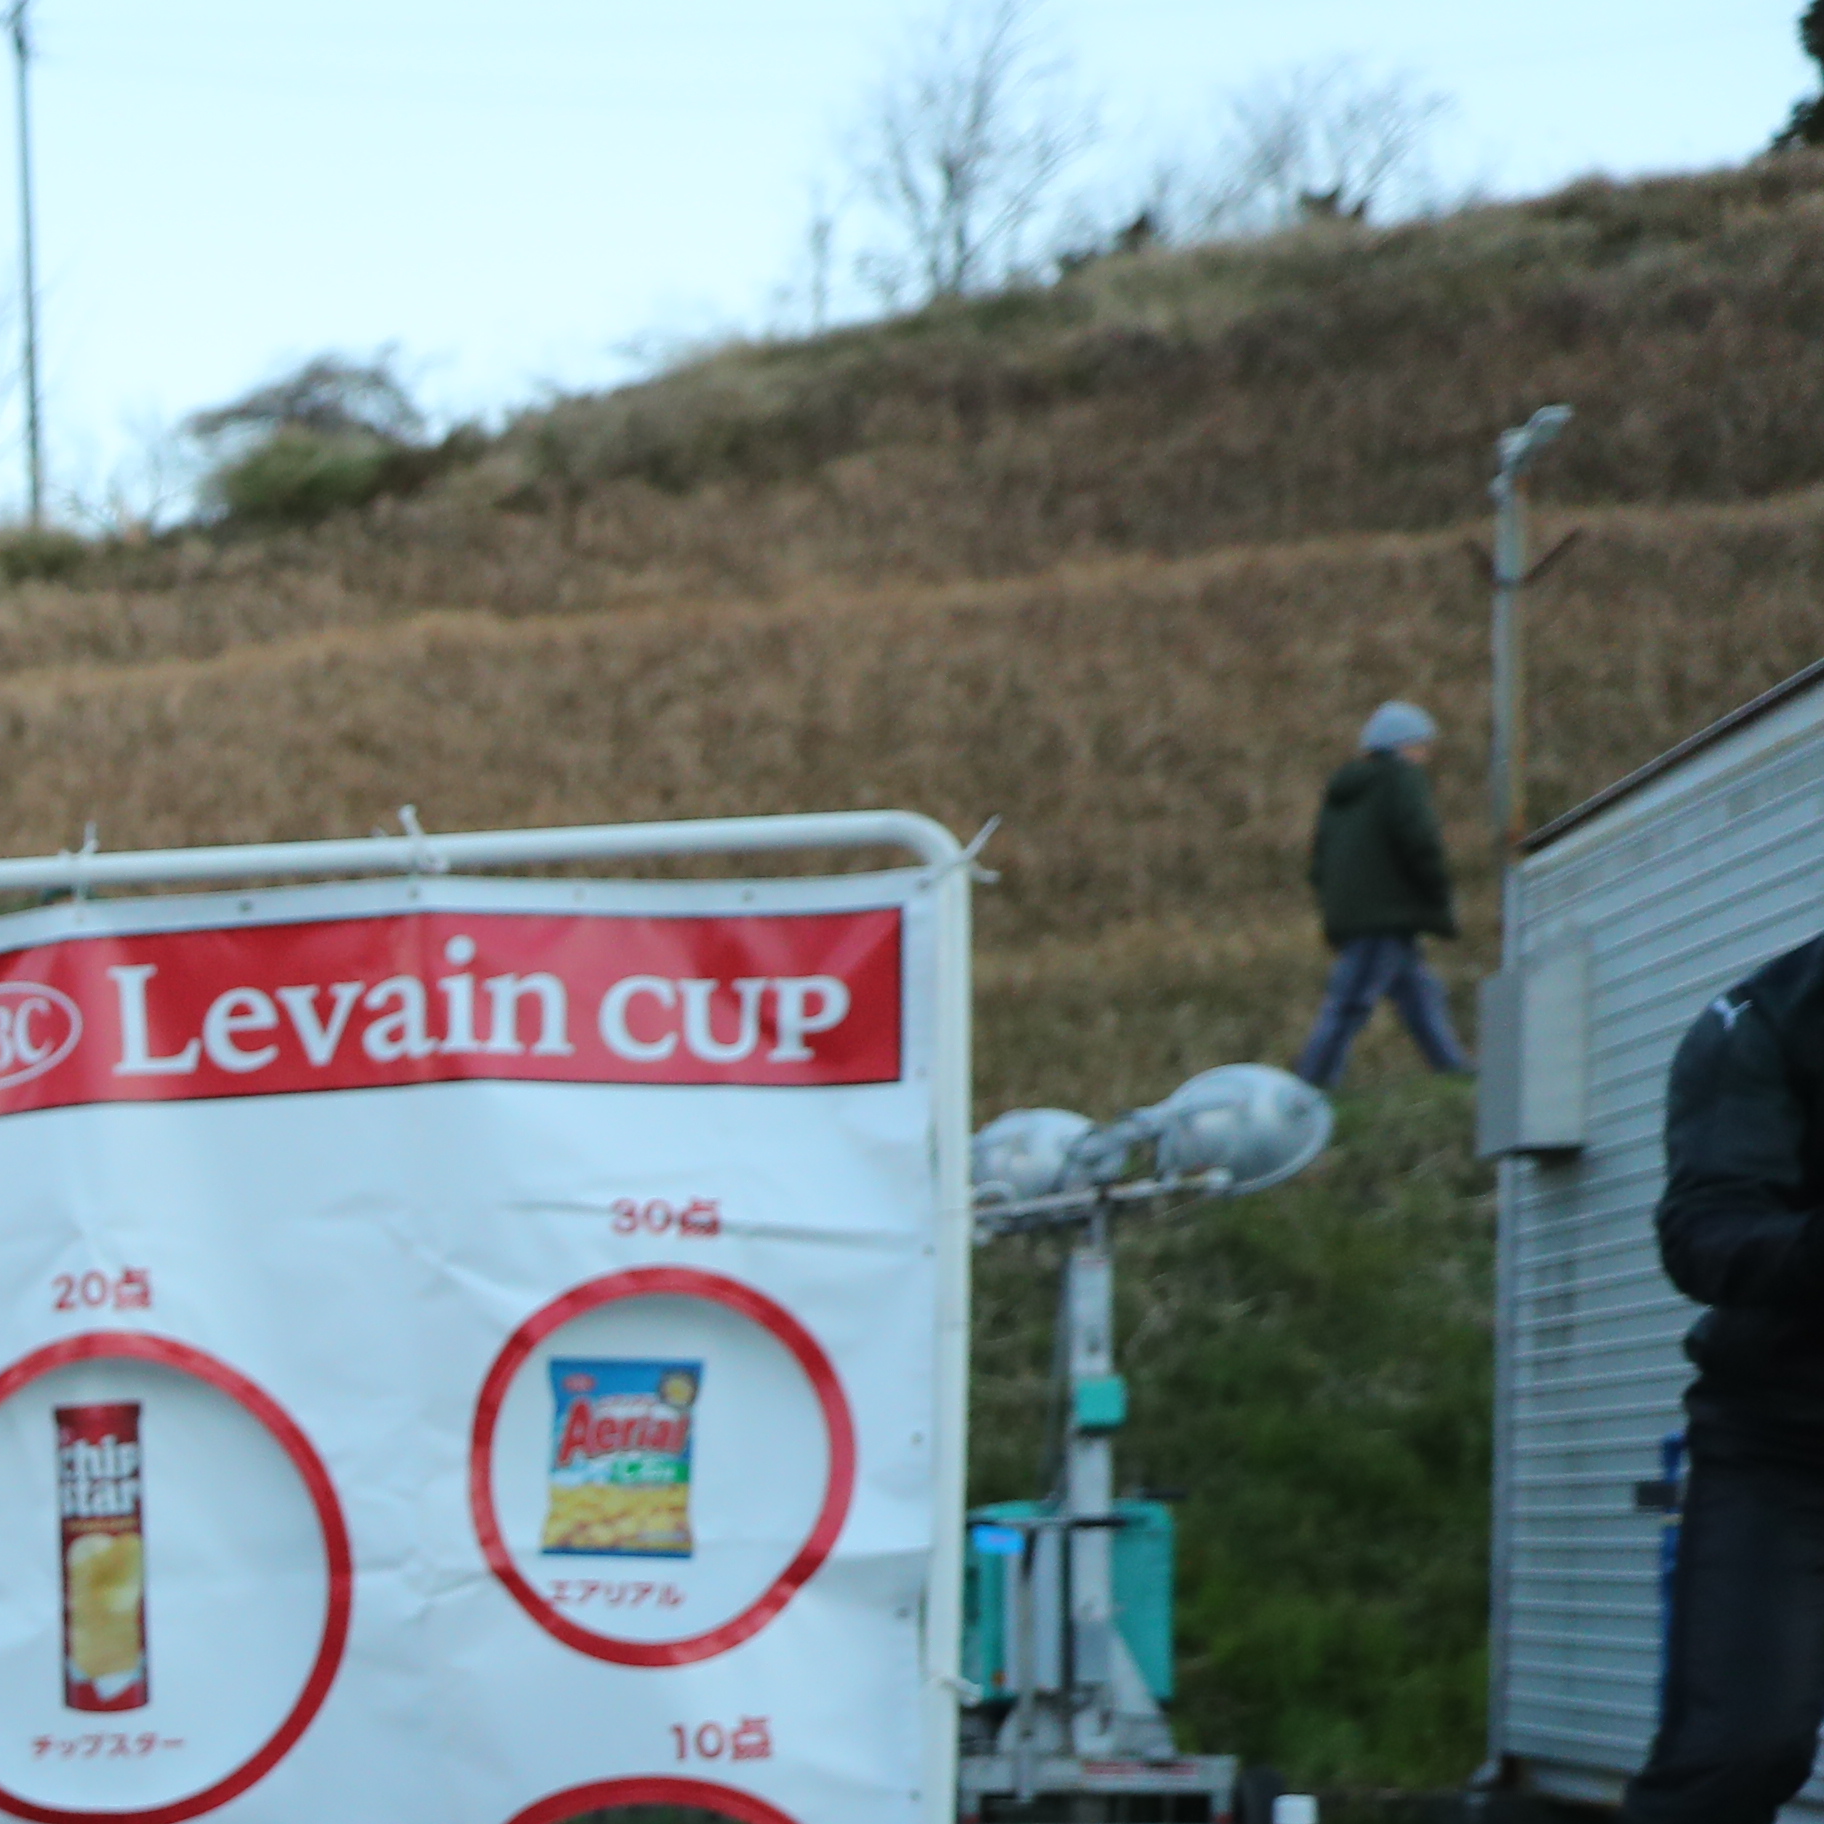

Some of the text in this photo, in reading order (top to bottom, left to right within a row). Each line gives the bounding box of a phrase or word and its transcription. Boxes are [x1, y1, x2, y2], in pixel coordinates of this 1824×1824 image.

[106, 935, 575, 1076] Levain
[597, 973, 851, 1064] CUP
[610, 1198, 723, 1238] 30点
[50, 1268, 155, 1312] 20点
[556, 1396, 691, 1468] Aerial
[549, 1577, 687, 1609] エアリアル
[29, 1732, 185, 1760] チップスター
[671, 1714, 772, 1760] 10点
